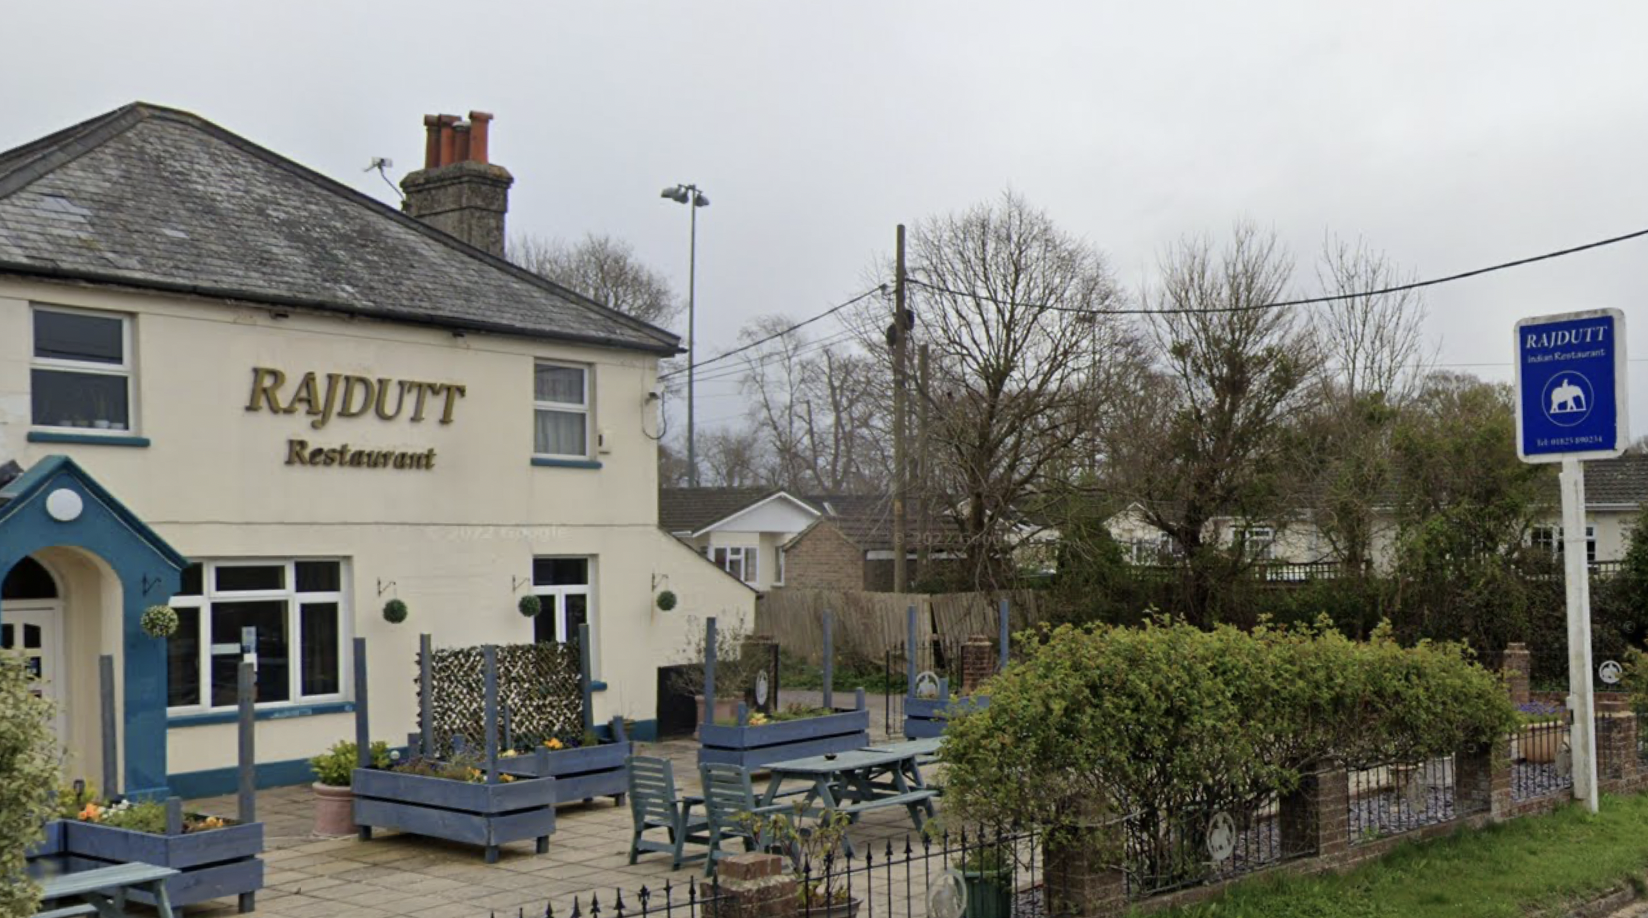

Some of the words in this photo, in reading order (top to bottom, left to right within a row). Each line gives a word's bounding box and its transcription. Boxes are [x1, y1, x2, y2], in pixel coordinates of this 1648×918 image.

[1526, 326, 1608, 348] RAJDUTT
[1554, 349, 1606, 361] Restaurant
[245, 366, 466, 430] RAJDUTT
[285, 438, 437, 470] Restaurant
